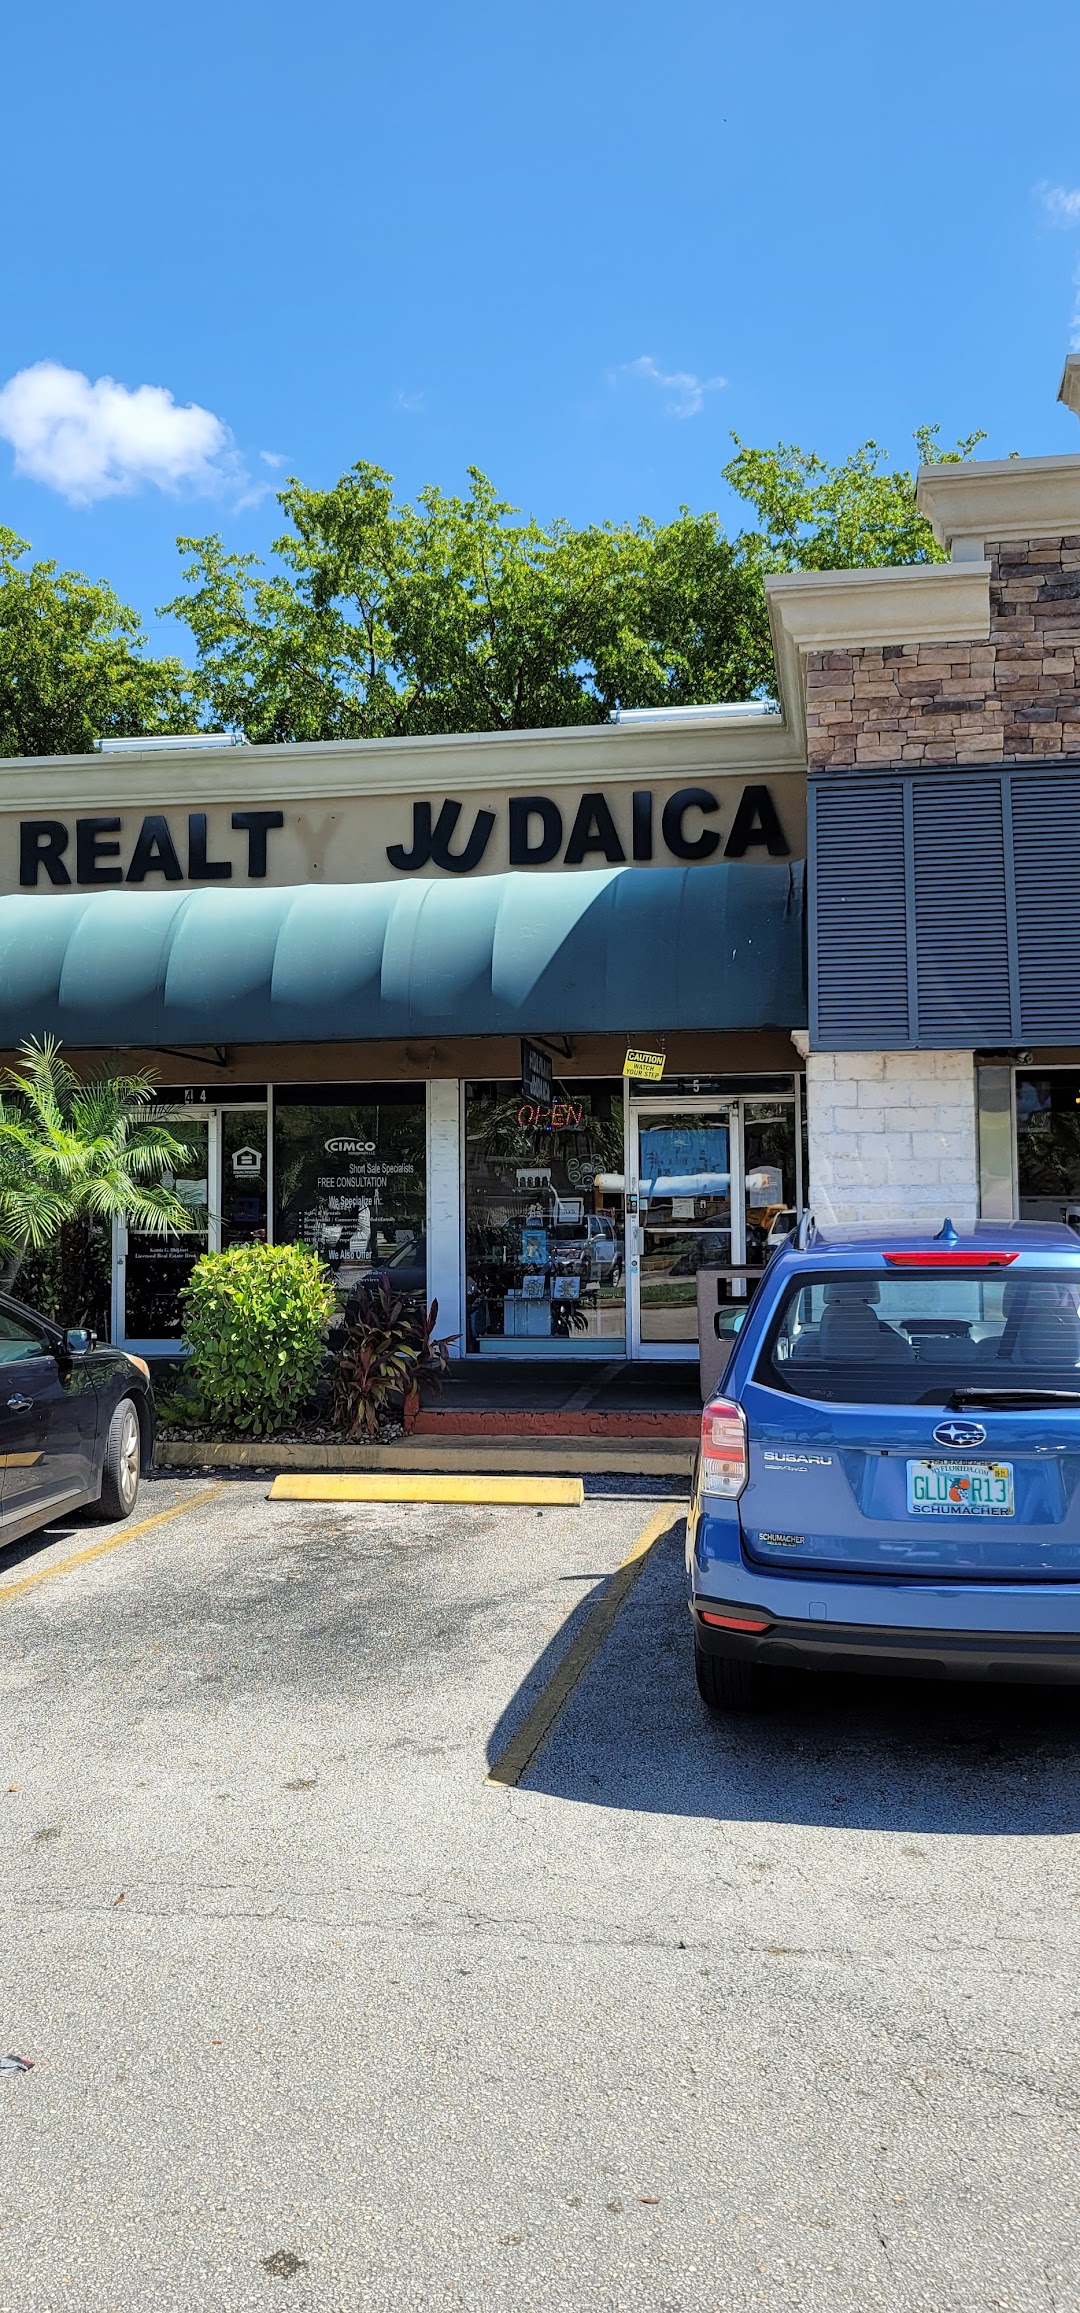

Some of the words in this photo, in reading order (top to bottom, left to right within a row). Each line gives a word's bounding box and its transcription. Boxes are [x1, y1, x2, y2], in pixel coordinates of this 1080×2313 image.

[386, 785, 790, 873] JUDAICA
[628, 1052, 664, 1065] CAUTION
[633, 1063, 655, 1071] WATCH
[626, 1068, 643, 1076] YOUR
[644, 1071, 660, 1079] STEP
[693, 1080, 700, 1092] 5
[200, 1090, 206, 1102] 4
[517, 1104, 583, 1125] OPEN
[330, 1142, 376, 1151] CIMCO
[349, 1163, 365, 1174] Short
[366, 1163, 380, 1174] Sale
[381, 1163, 414, 1175] Specialists
[317, 1177, 336, 1187] FREE
[336, 1177, 387, 1187] CONSULTATION
[329, 1196, 339, 1205] We
[340, 1196, 372, 1208] Specialize
[328, 1250, 339, 1260] We
[340, 1250, 355, 1259] Also
[356, 1250, 372, 1259] Offer
[764, 1451, 832, 1465] SUBARU
[931, 1465, 989, 1476] MYFLORIDA.COM
[914, 1476, 948, 1501] GLU
[972, 1478, 1007, 1502] R13
[913, 1505, 1009, 1515] SCHUMACHER
[759, 1533, 805, 1544] SCHUMACHER
